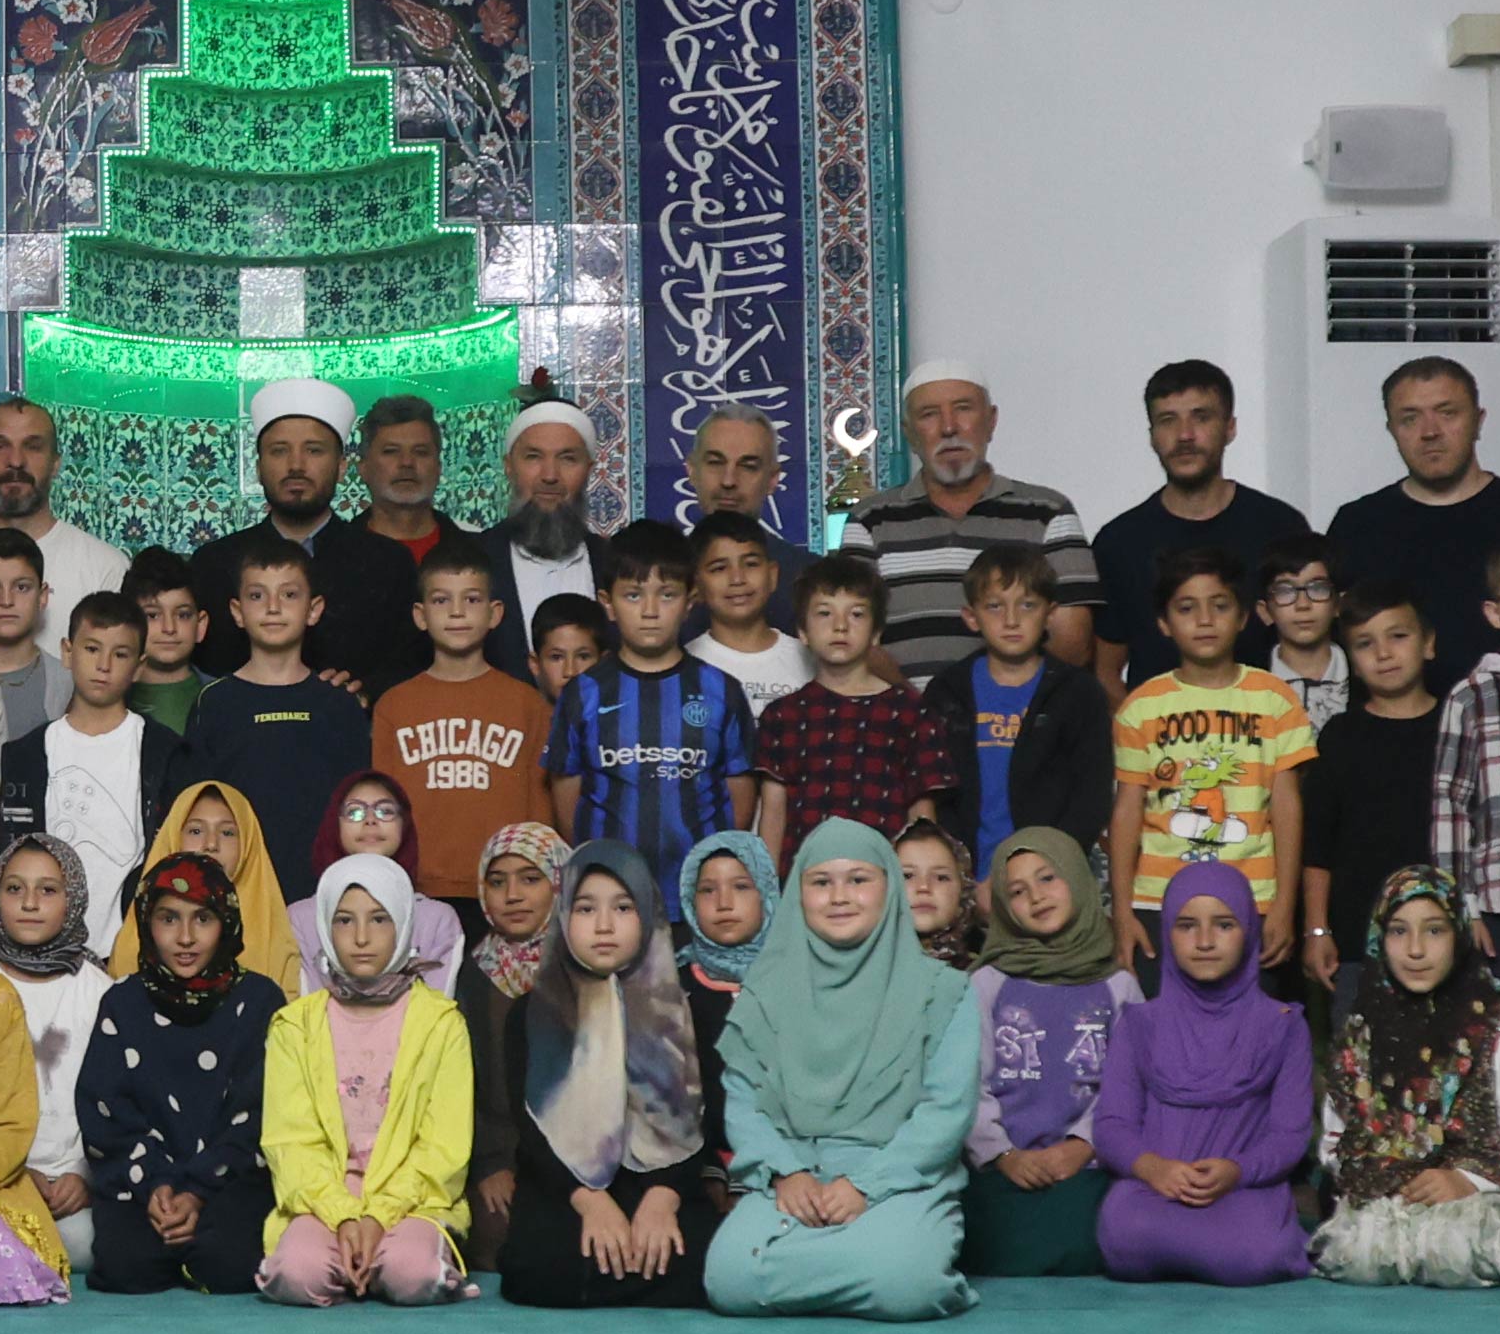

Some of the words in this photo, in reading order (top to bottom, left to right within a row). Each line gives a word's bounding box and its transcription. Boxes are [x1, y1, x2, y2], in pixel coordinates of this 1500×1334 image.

[396, 717, 525, 768] CHICAGO
[1157, 710, 1209, 747] GOOD
[1216, 710, 1262, 746] TIME
[597, 743, 707, 768] betsson
[426, 760, 490, 790] 1986
